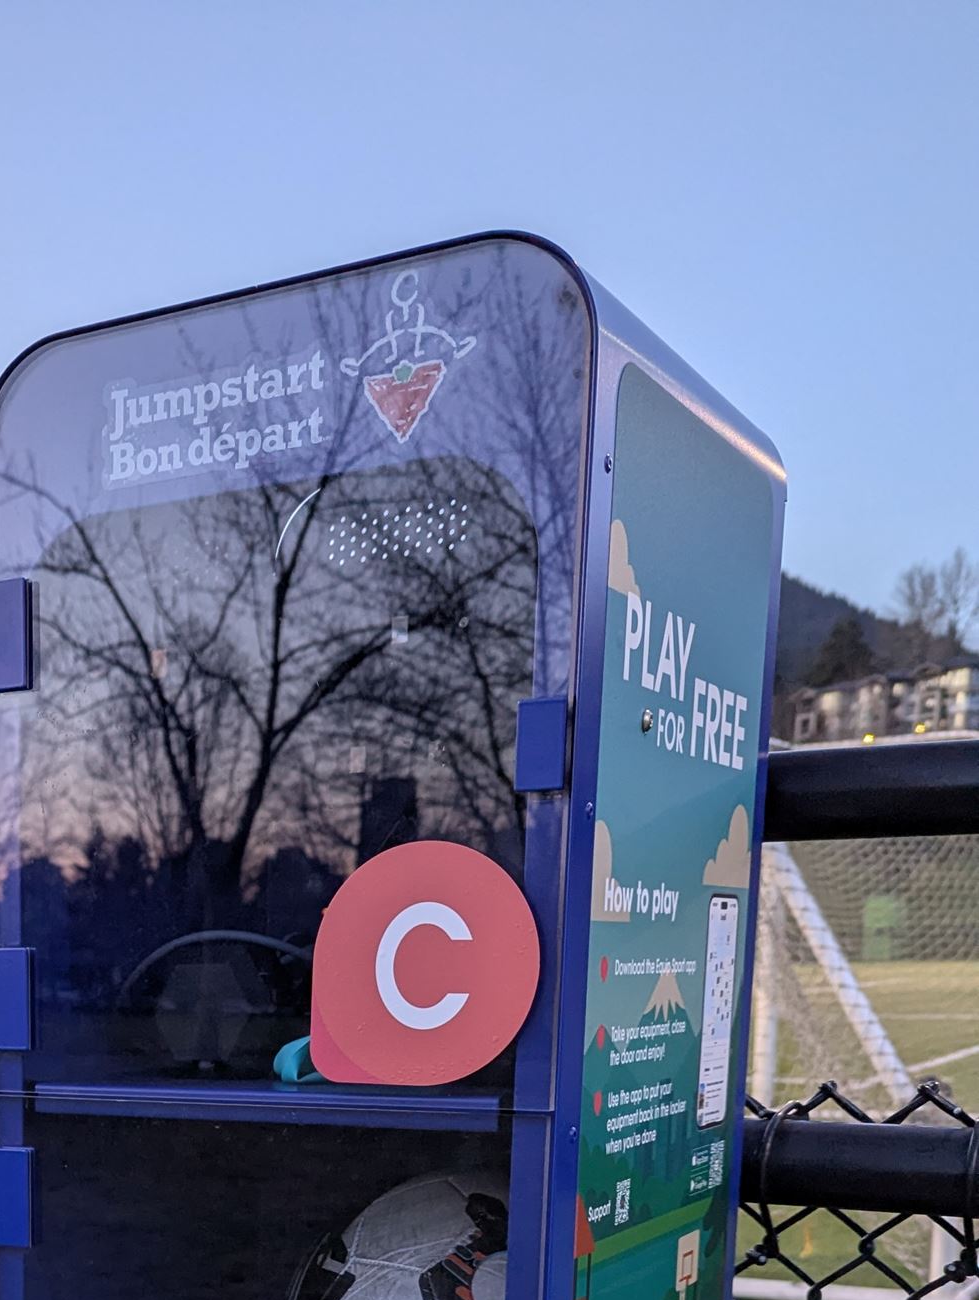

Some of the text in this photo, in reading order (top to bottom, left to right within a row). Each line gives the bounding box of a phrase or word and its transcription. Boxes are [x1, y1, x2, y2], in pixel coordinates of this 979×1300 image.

[110, 350, 325, 441] Jumpstart
[109, 407, 324, 481] Bon départ
[623, 591, 696, 702] PLAY
[656, 677, 748, 771] FOR FREE
[603, 877, 680, 922] How to play
[375, 901, 474, 1030] C
[614, 958, 646, 976] Download
[645, 958, 656, 974] the
[611, 1025, 625, 1043] Take
[626, 1026, 640, 1044] your
[671, 1019, 686, 1034] close
[609, 1049, 620, 1066] the
[620, 1047, 635, 1065] door
[635, 1044, 647, 1062] and
[607, 1081, 673, 1108] Use the app to put your
[606, 1098, 687, 1134] equipment back in the locker
[605, 1128, 657, 1155] when you're done
[587, 1199, 611, 1223] Support
